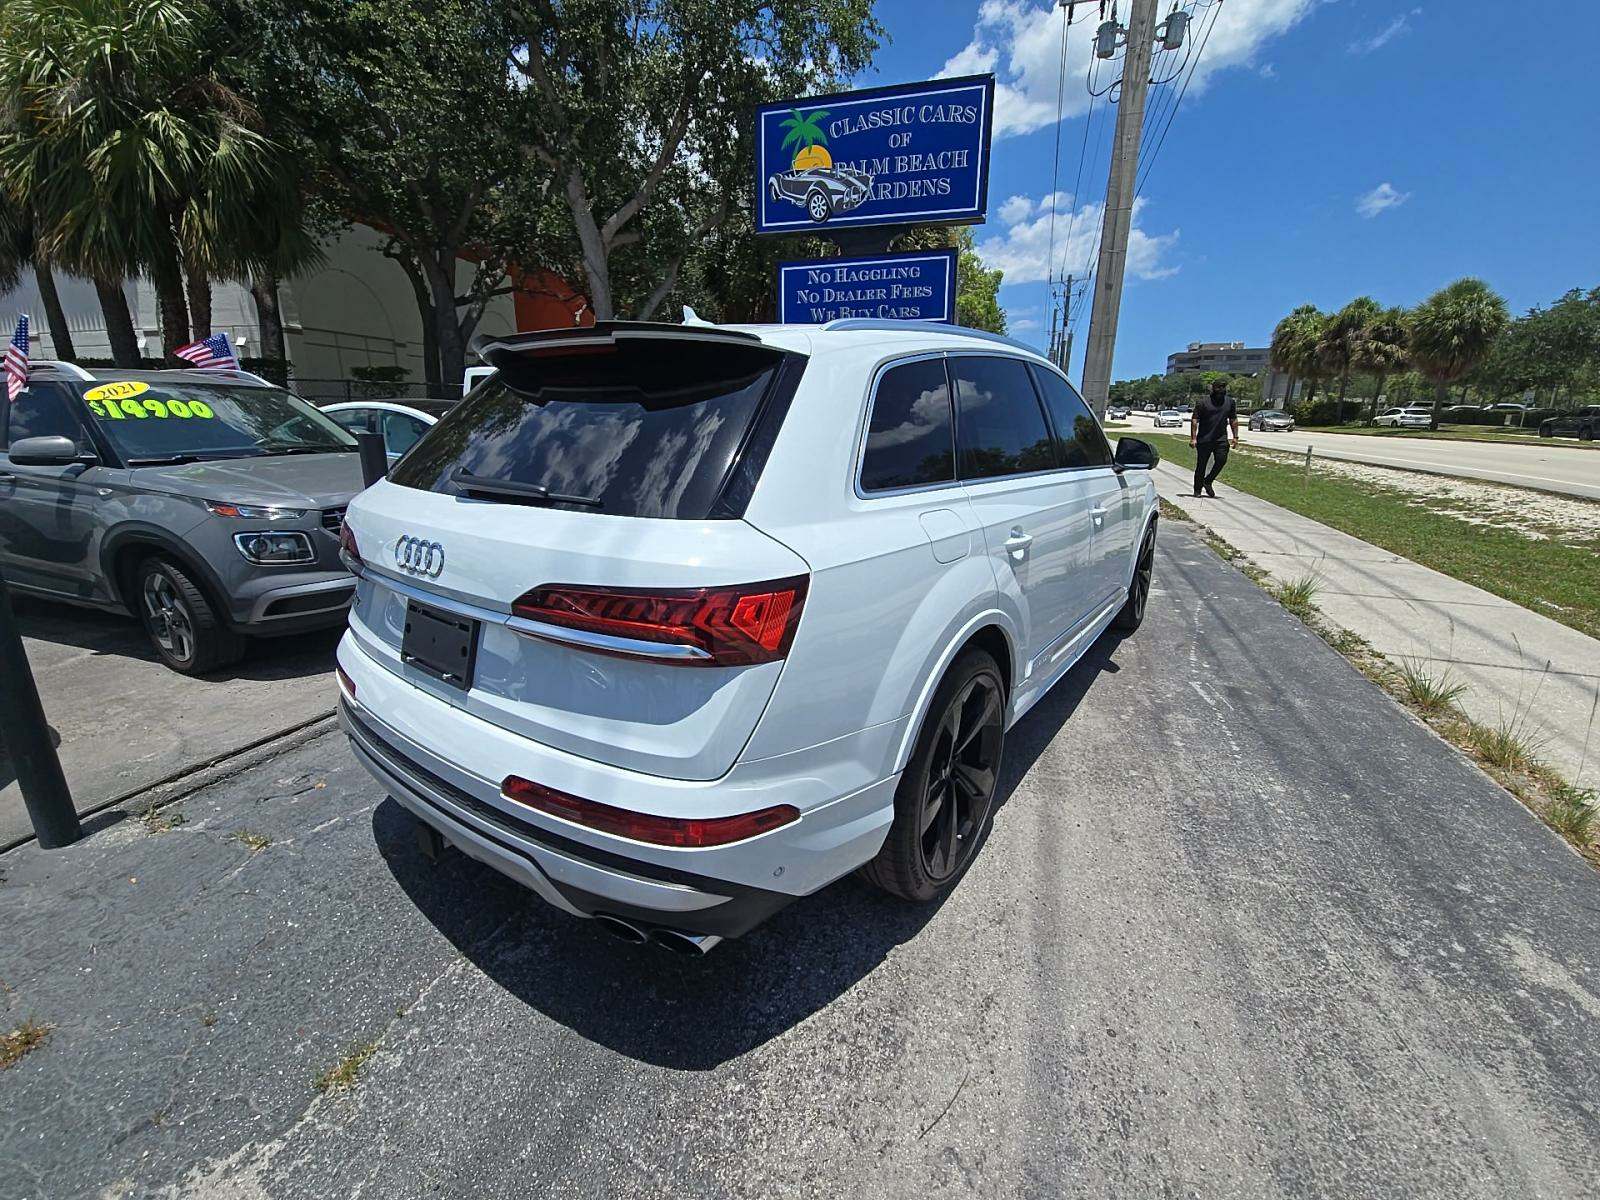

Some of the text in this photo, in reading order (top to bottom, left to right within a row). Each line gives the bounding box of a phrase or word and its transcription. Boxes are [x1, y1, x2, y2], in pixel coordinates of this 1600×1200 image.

[829, 104, 978, 139] CLASSIC CARS
[888, 132, 912, 149] OF
[833, 149, 969, 179] PALM BEACH
[96, 382, 137, 400] 2021
[88, 399, 215, 420] $14900
